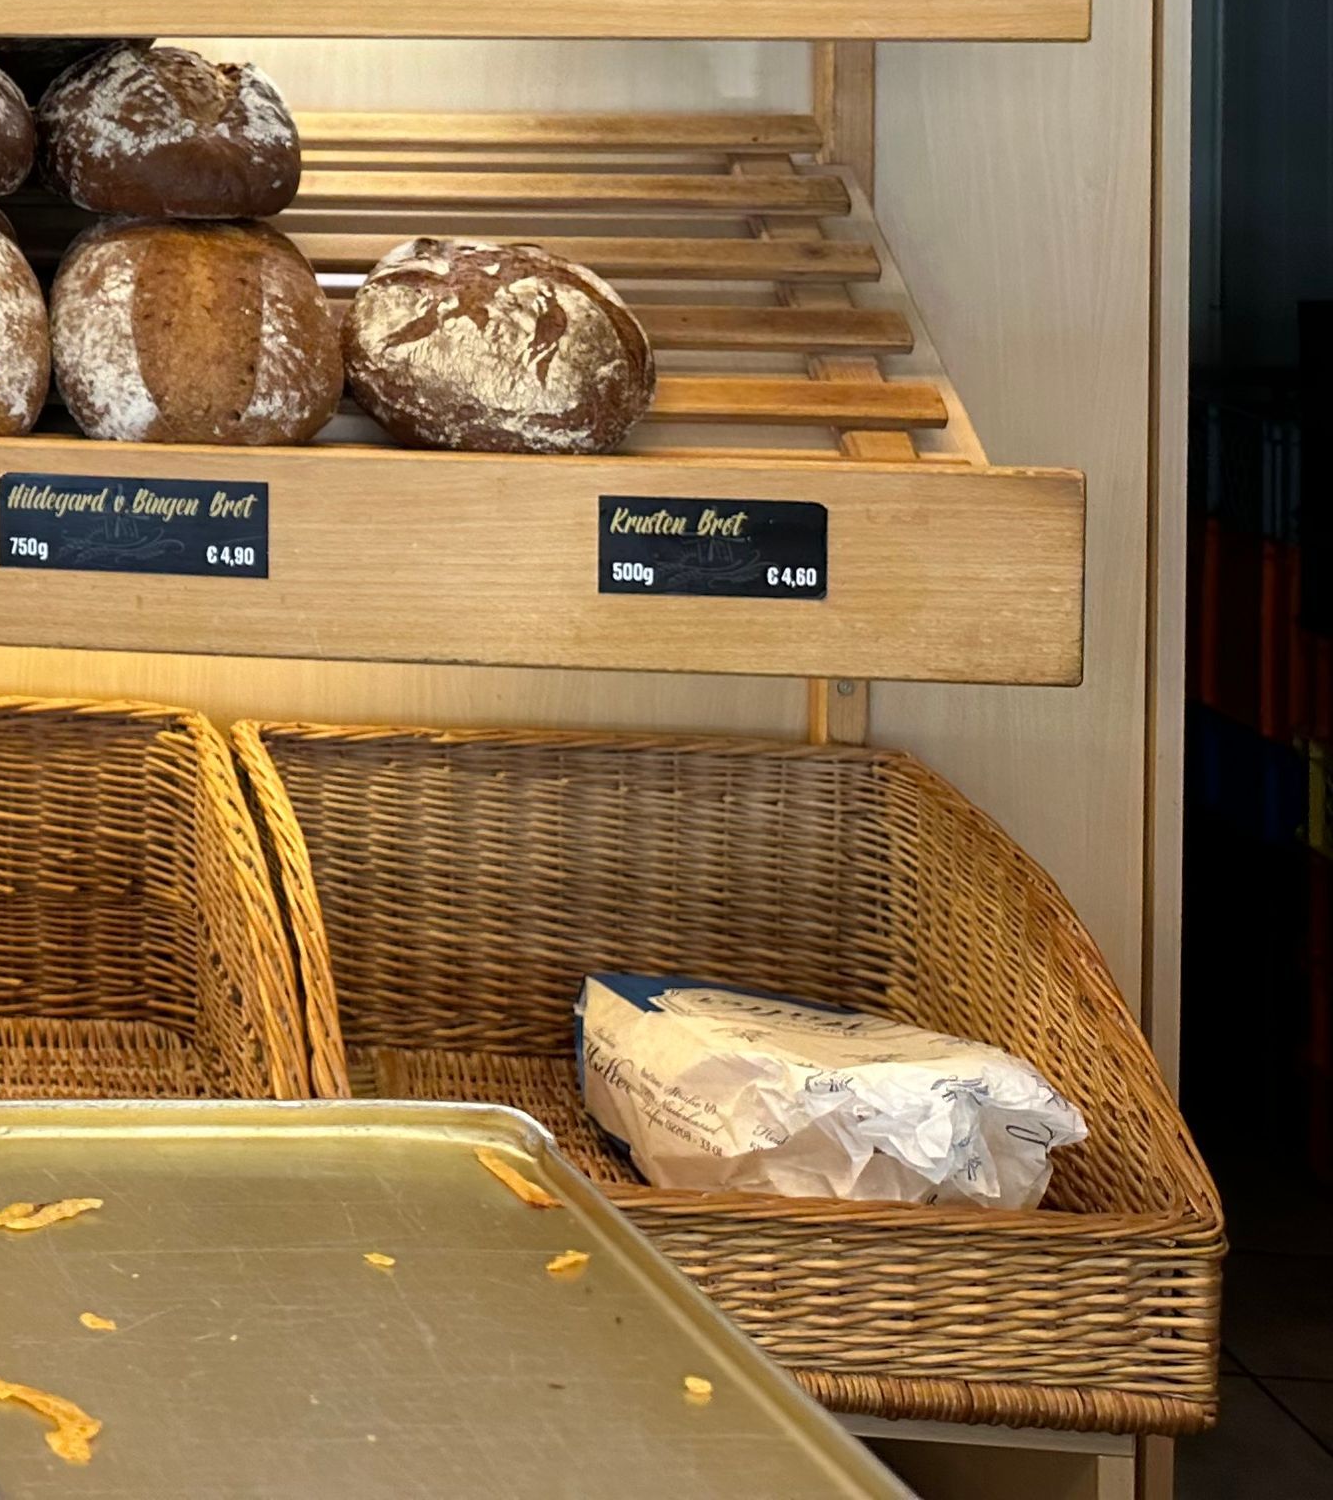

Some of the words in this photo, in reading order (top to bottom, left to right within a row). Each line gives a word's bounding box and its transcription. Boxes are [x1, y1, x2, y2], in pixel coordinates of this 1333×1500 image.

[7, 483, 109, 517] Hildegard
[209, 490, 258, 518] Brot
[610, 506, 687, 535] Krusten
[697, 508, 748, 536] Brot
